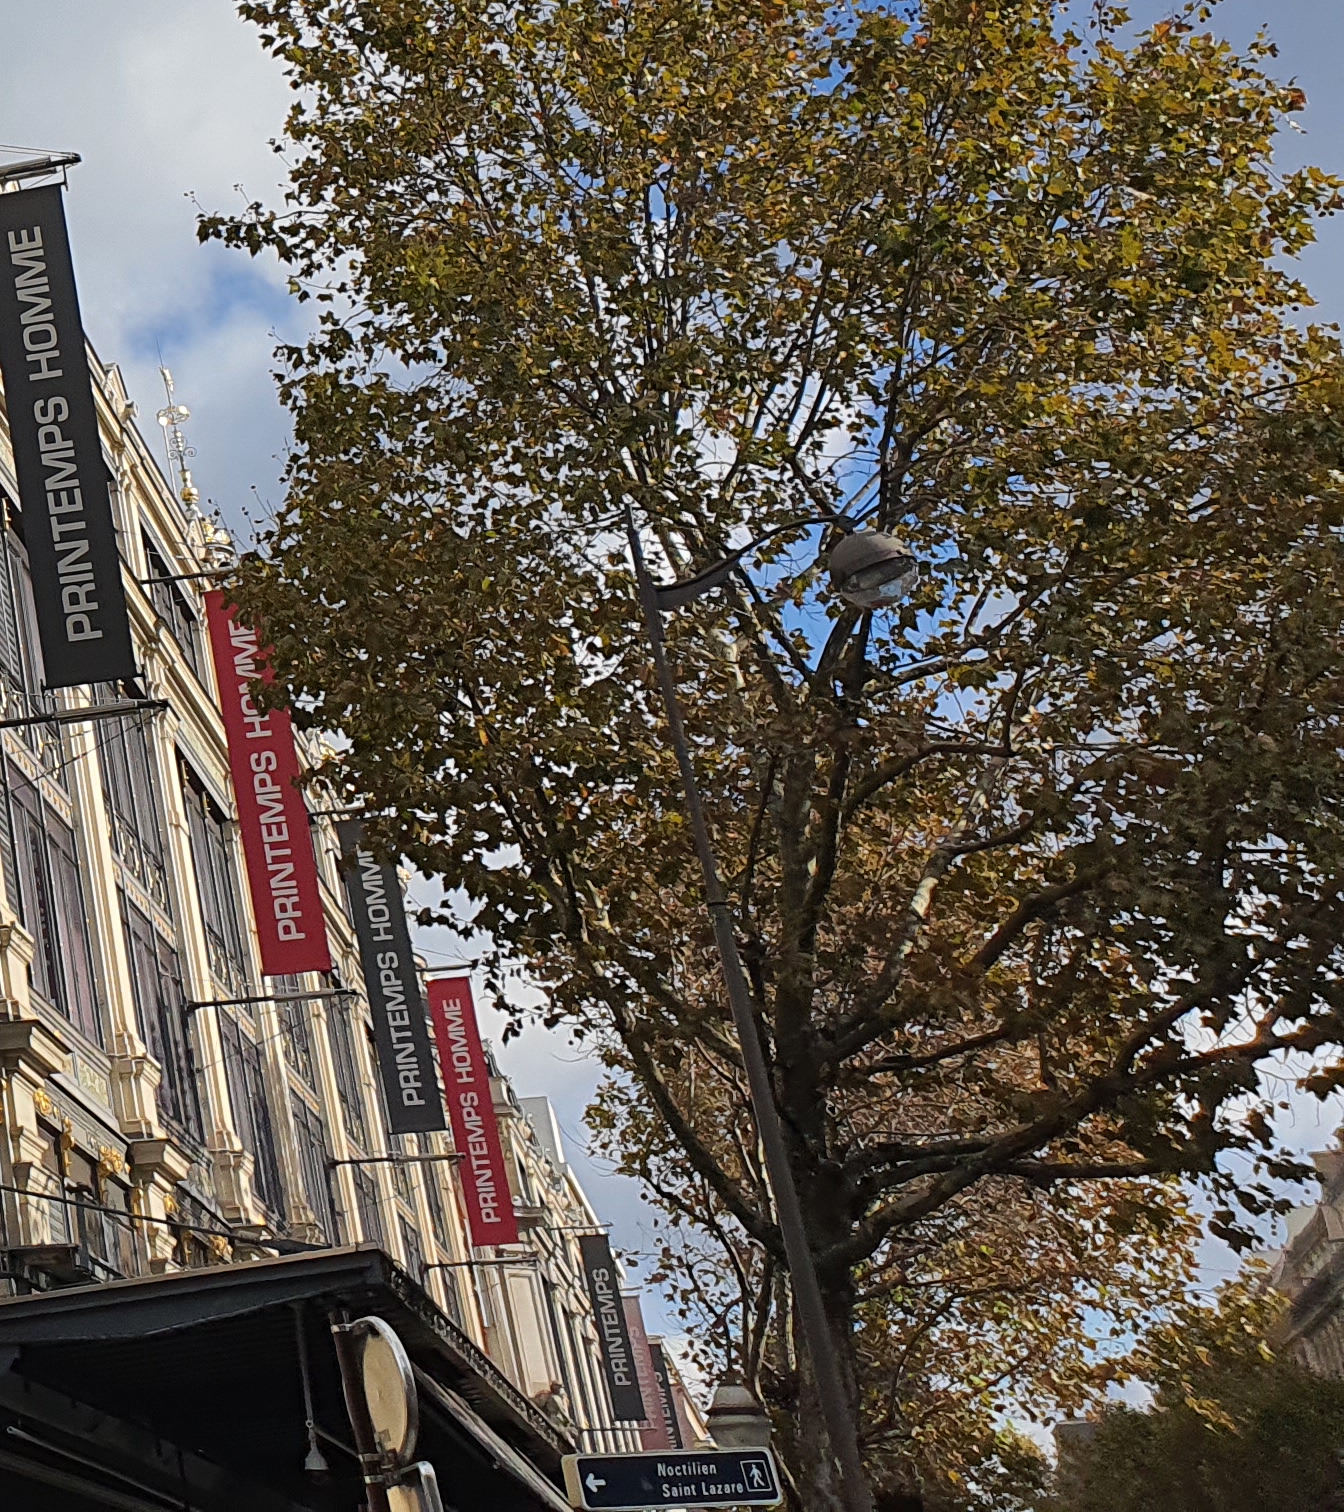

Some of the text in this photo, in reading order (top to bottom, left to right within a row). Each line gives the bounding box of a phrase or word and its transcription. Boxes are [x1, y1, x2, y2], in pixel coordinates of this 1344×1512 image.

[7, 225, 104, 643] PRINTEMPS HOMME
[250, 749, 306, 943] PRINTEMPS
[376, 949, 426, 1108] PRINTEMPS
[441, 997, 502, 1225] PRINTEMPS HOMME
[591, 1267, 632, 1387] PRINTEMPS
[657, 1461, 717, 1477] Noctilien
[662, 1480, 744, 1498] Saint Lazare
